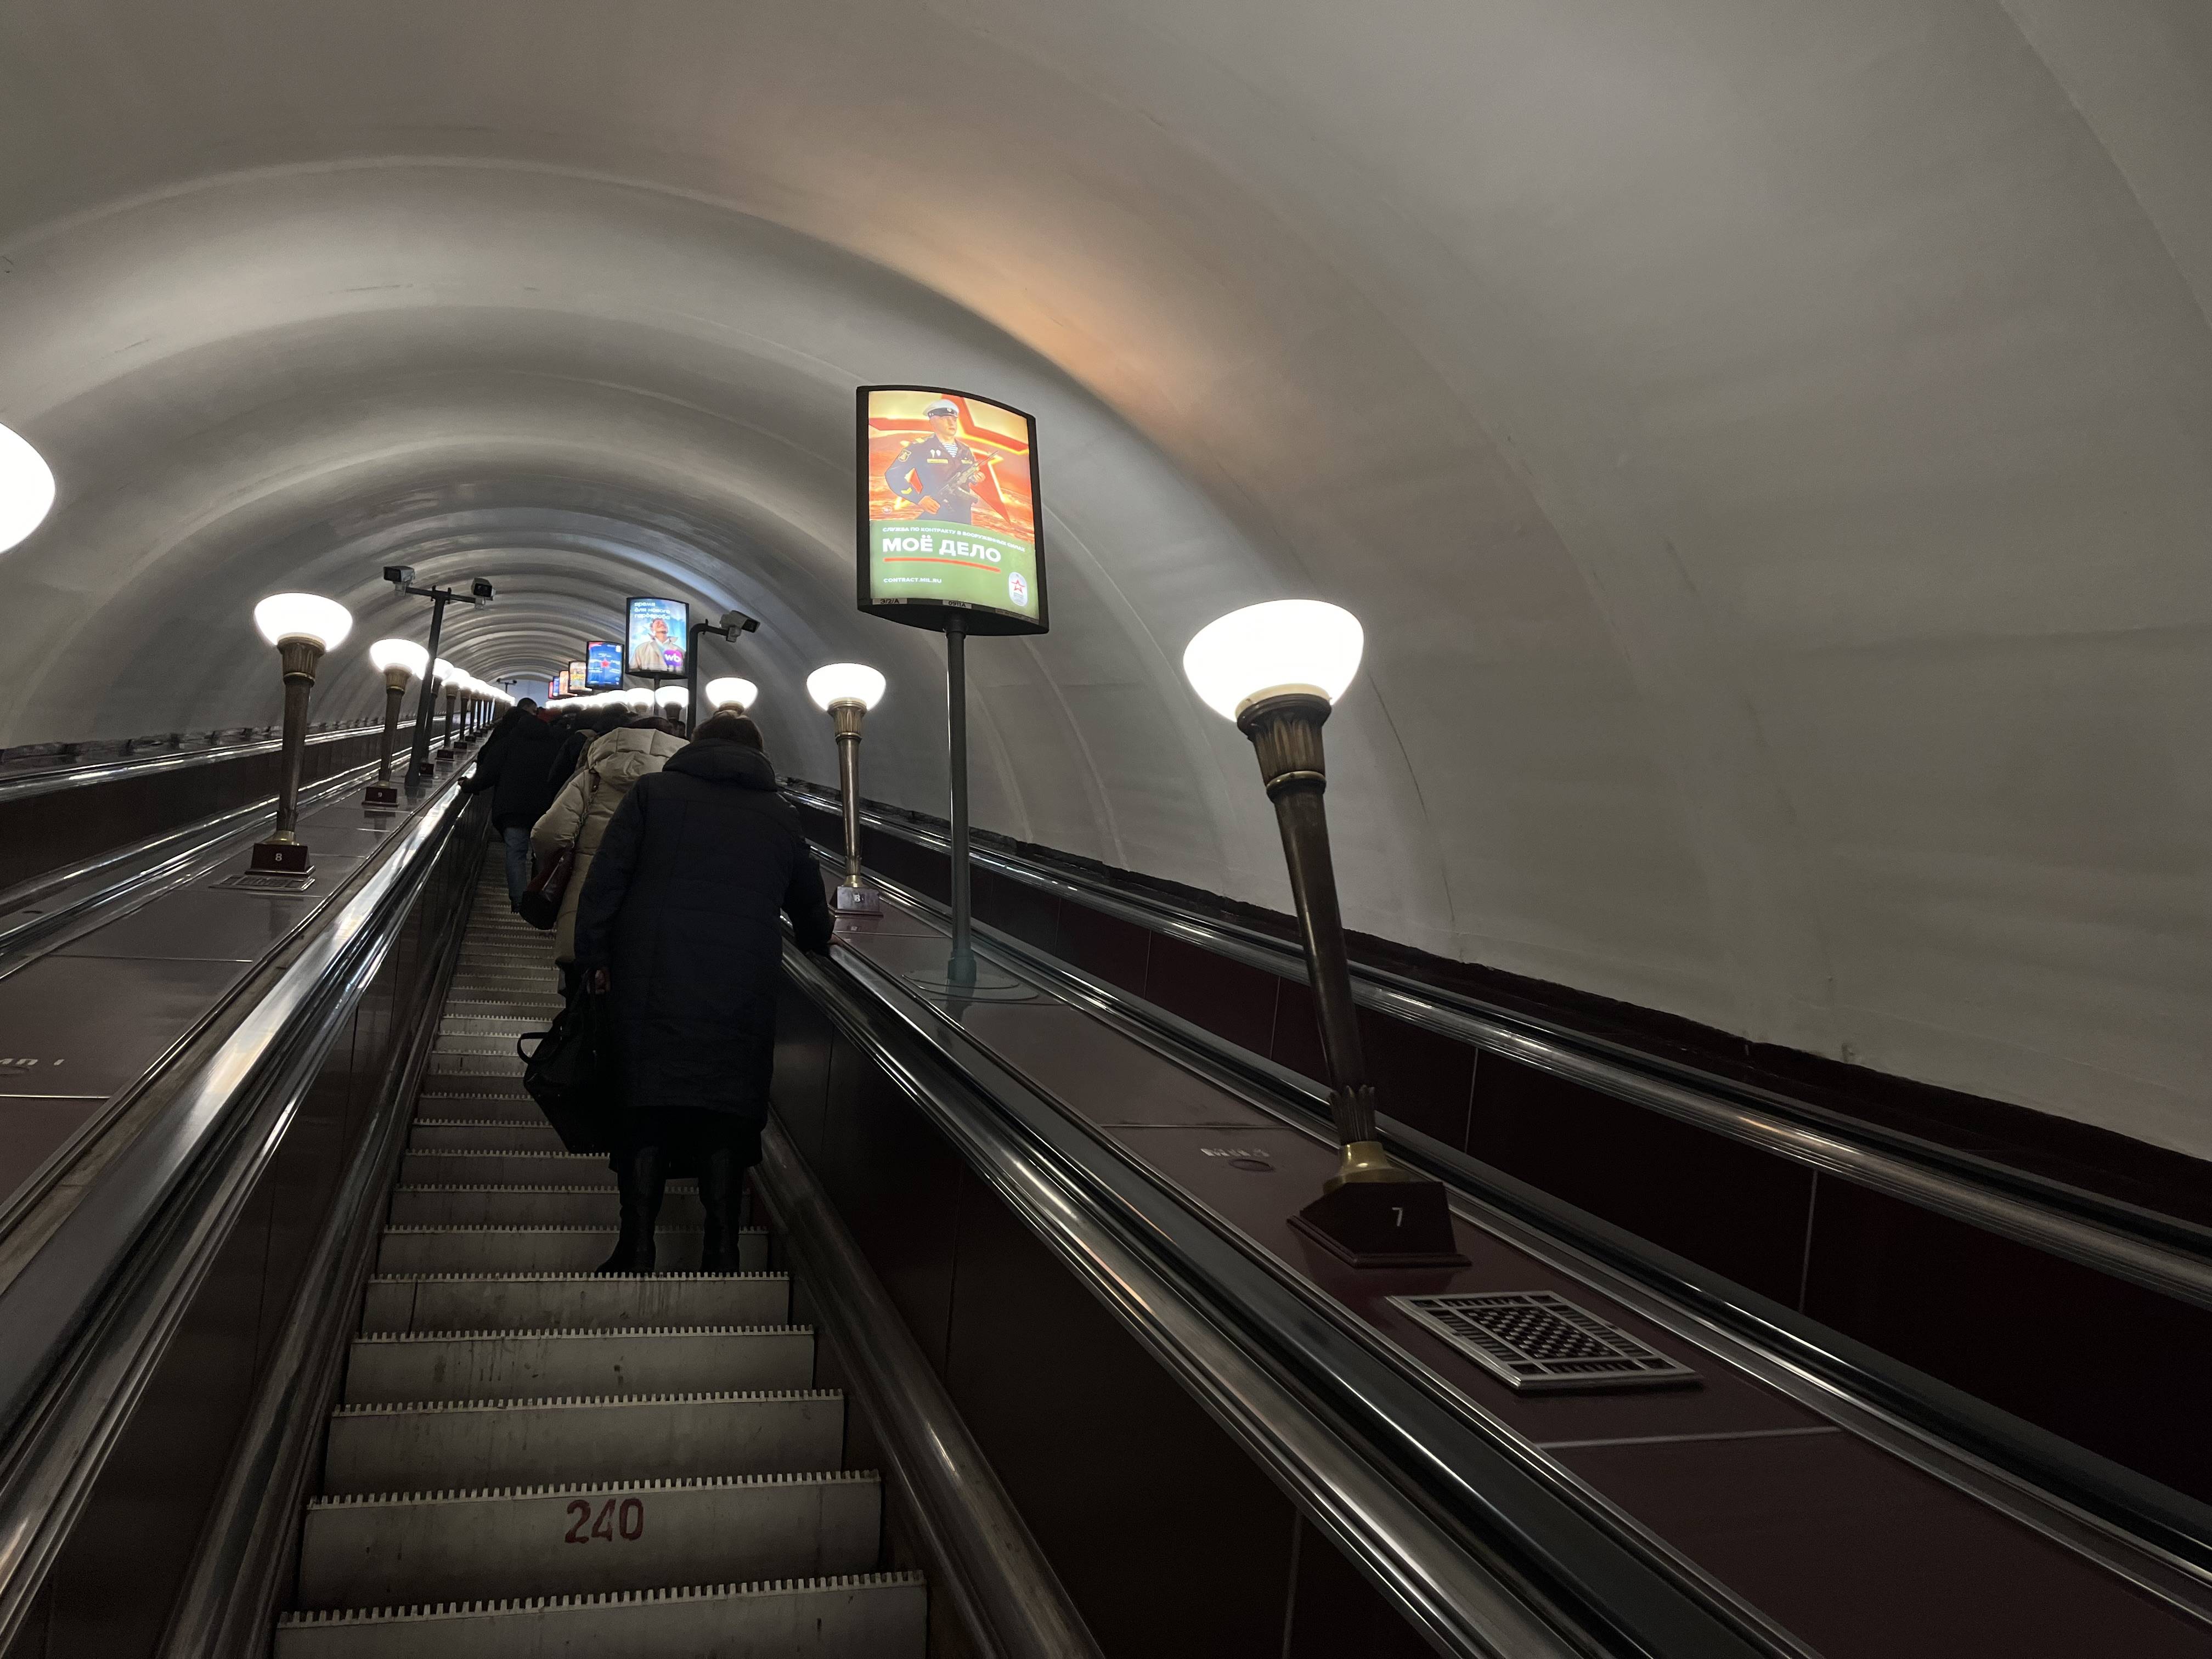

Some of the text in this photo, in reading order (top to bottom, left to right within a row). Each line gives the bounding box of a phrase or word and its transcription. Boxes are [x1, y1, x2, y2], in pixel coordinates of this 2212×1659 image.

[882, 534, 1001, 562] МОЁ ДЕЛО
[664, 653, 681, 663] wb
[275, 853, 283, 862] 8
[1392, 1207, 1404, 1227] 7
[565, 1497, 644, 1544] 240
